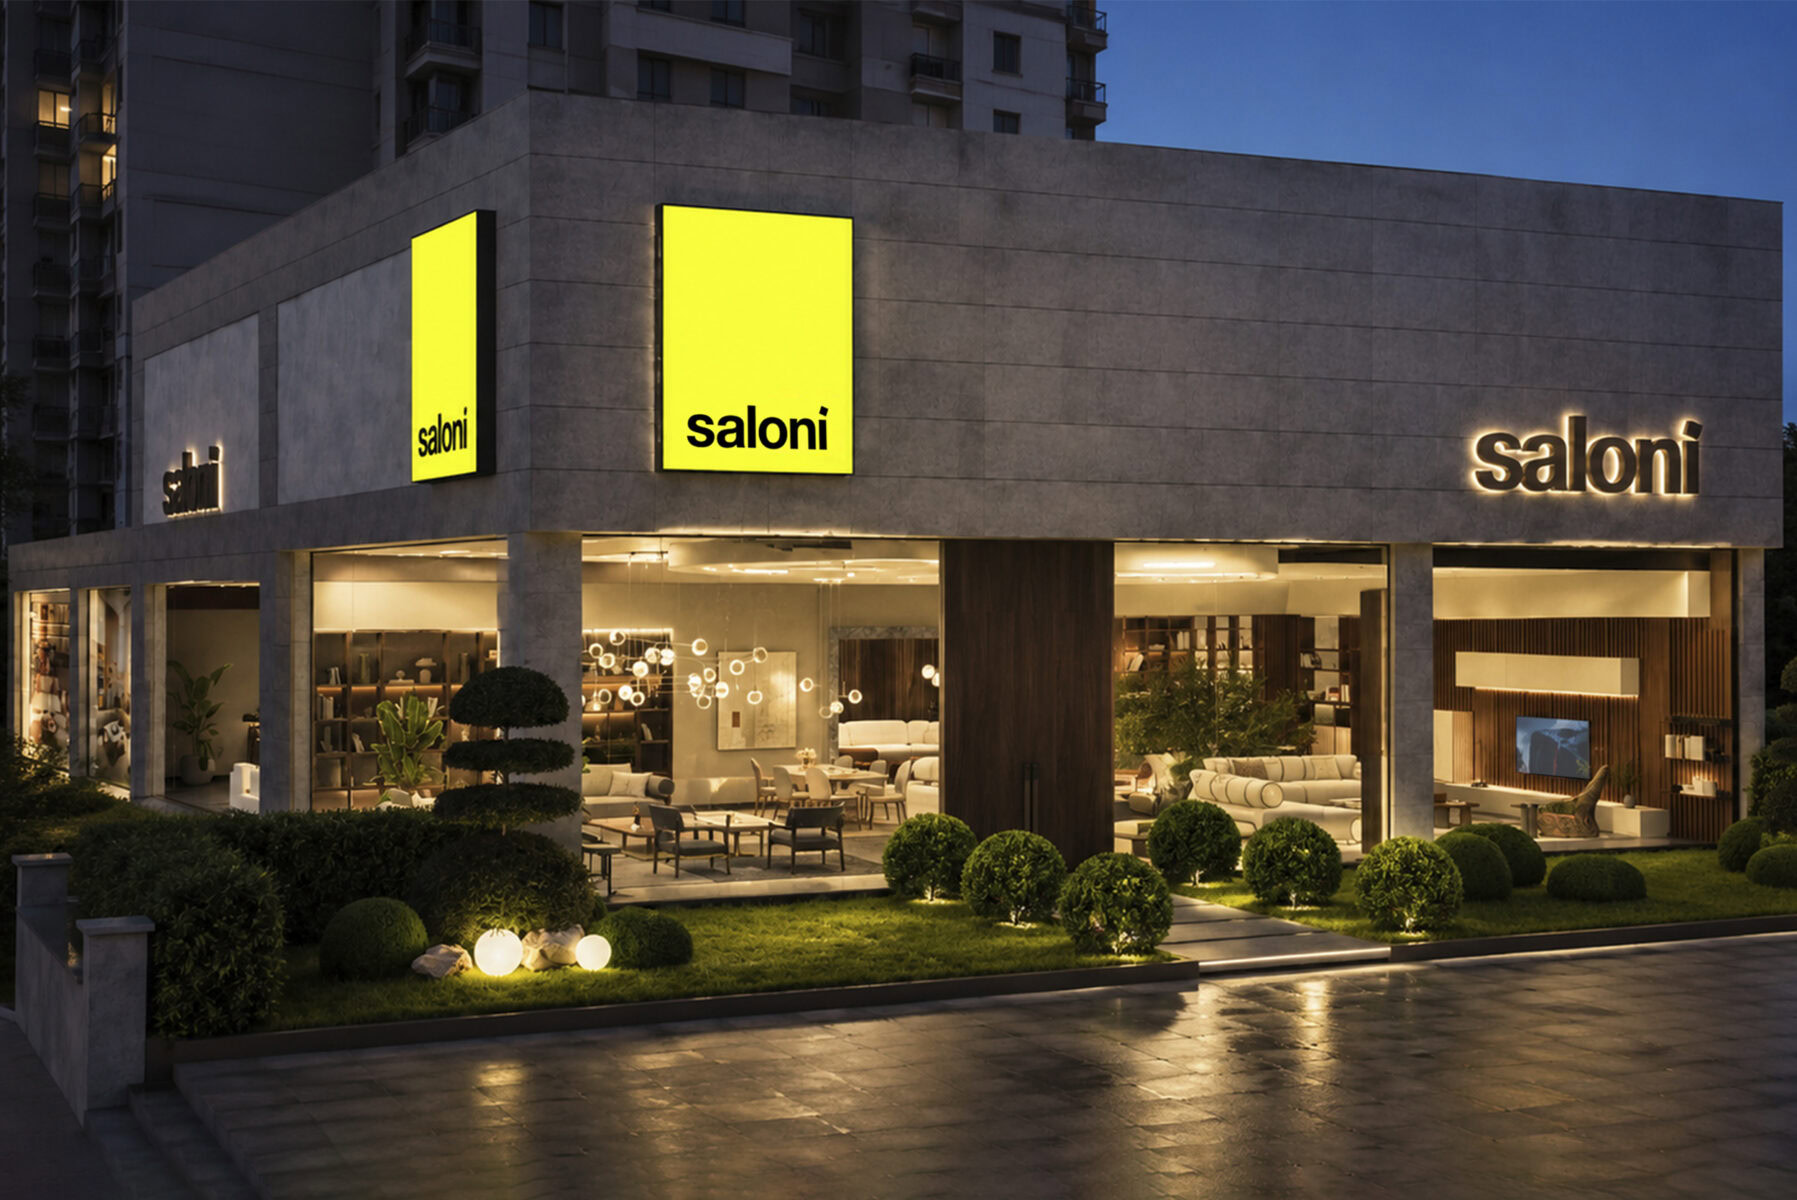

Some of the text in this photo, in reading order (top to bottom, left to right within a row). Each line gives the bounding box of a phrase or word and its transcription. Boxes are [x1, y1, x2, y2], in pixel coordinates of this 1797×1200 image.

[418, 406, 467, 457] saloni
[686, 405, 829, 450] saloni
[1474, 415, 1703, 494] saloni
